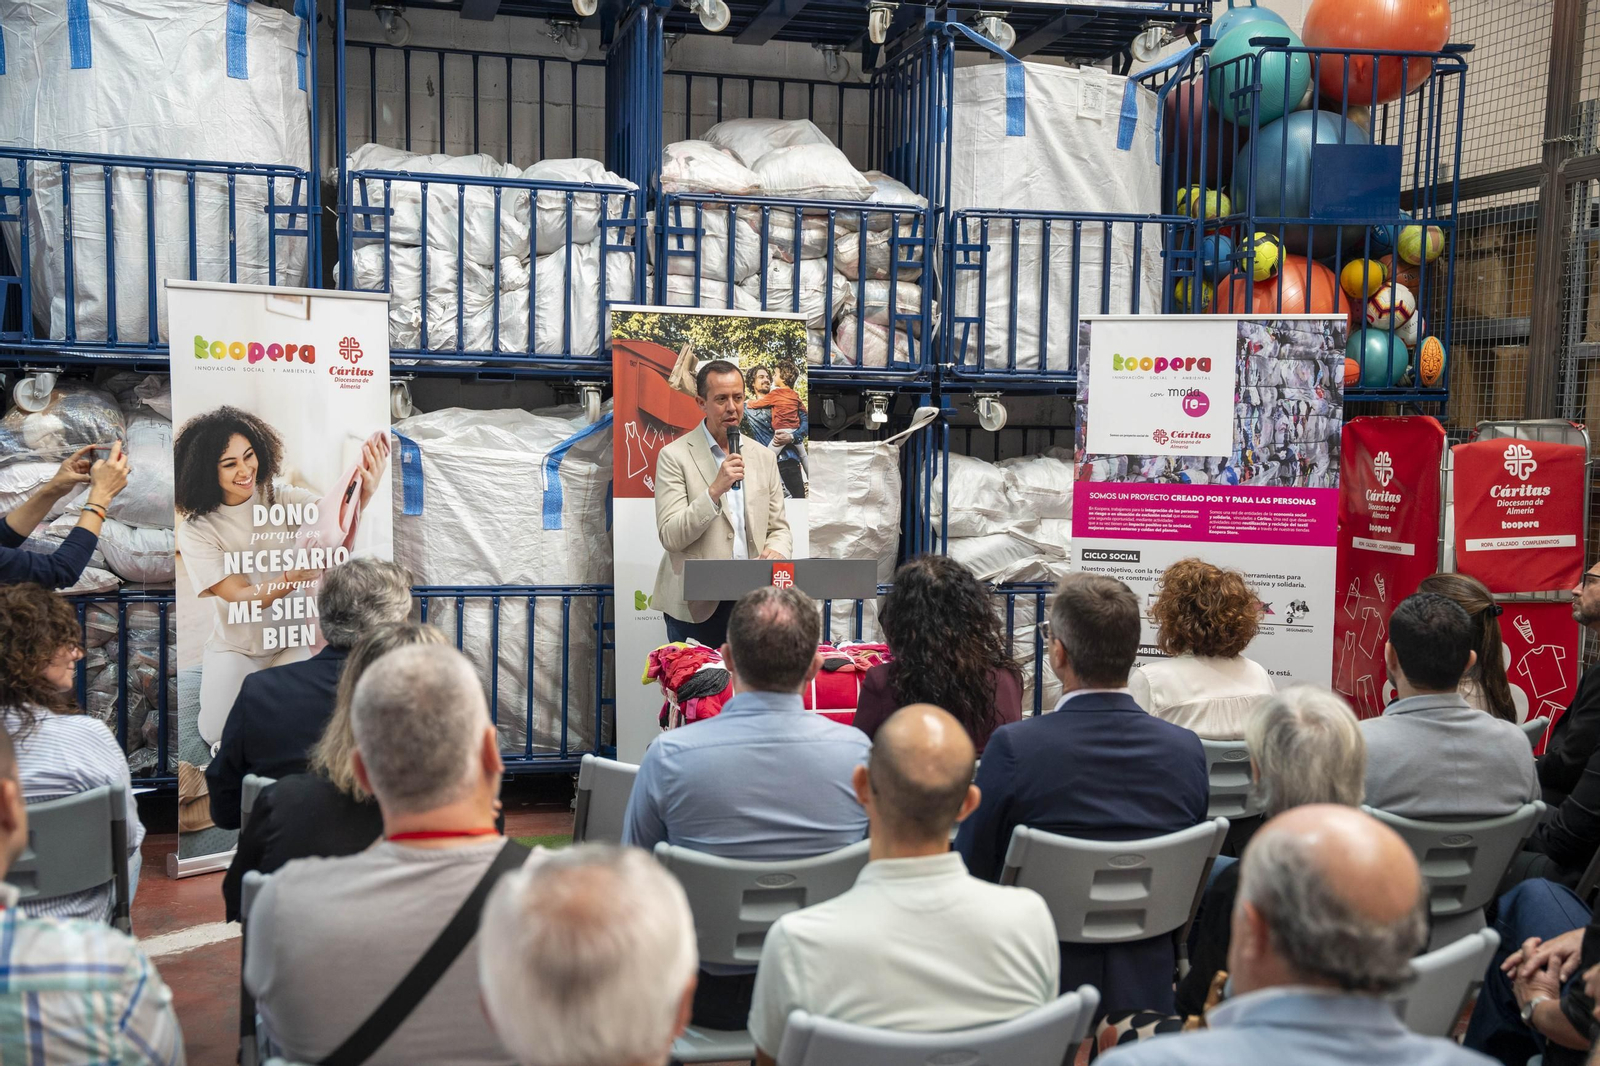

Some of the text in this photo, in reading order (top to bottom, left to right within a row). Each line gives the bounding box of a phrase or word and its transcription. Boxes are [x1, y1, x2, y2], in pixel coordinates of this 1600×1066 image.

[194, 335, 316, 364] koopera
[329, 364, 374, 377] Cáritas
[1112, 354, 1212, 374] koopera
[1168, 386, 1201, 397] moda
[1170, 430, 1212, 440] Cáritas
[1366, 489, 1402, 504] Cáritas
[1490, 484, 1551, 498] Cáritas
[1090, 492, 1116, 500] SOMOS
[1130, 494, 1170, 502] PROYECTO
[1273, 498, 1316, 506] PERSONAS
[253, 502, 320, 526] DONO
[1368, 502, 1390, 512] Diocesana
[1506, 507, 1534, 515] Almería
[1372, 512, 1390, 520] Almería
[1502, 520, 1540, 530] koopera
[250, 528, 320, 544] porque es
[224, 546, 349, 575] NECESARIO
[1109, 552, 1138, 560] SOCIAL
[253, 578, 318, 596] y porque
[227, 596, 319, 624] ME SIEN
[263, 624, 316, 650] BIEN
[1136, 647, 1167, 655] MBIENT
